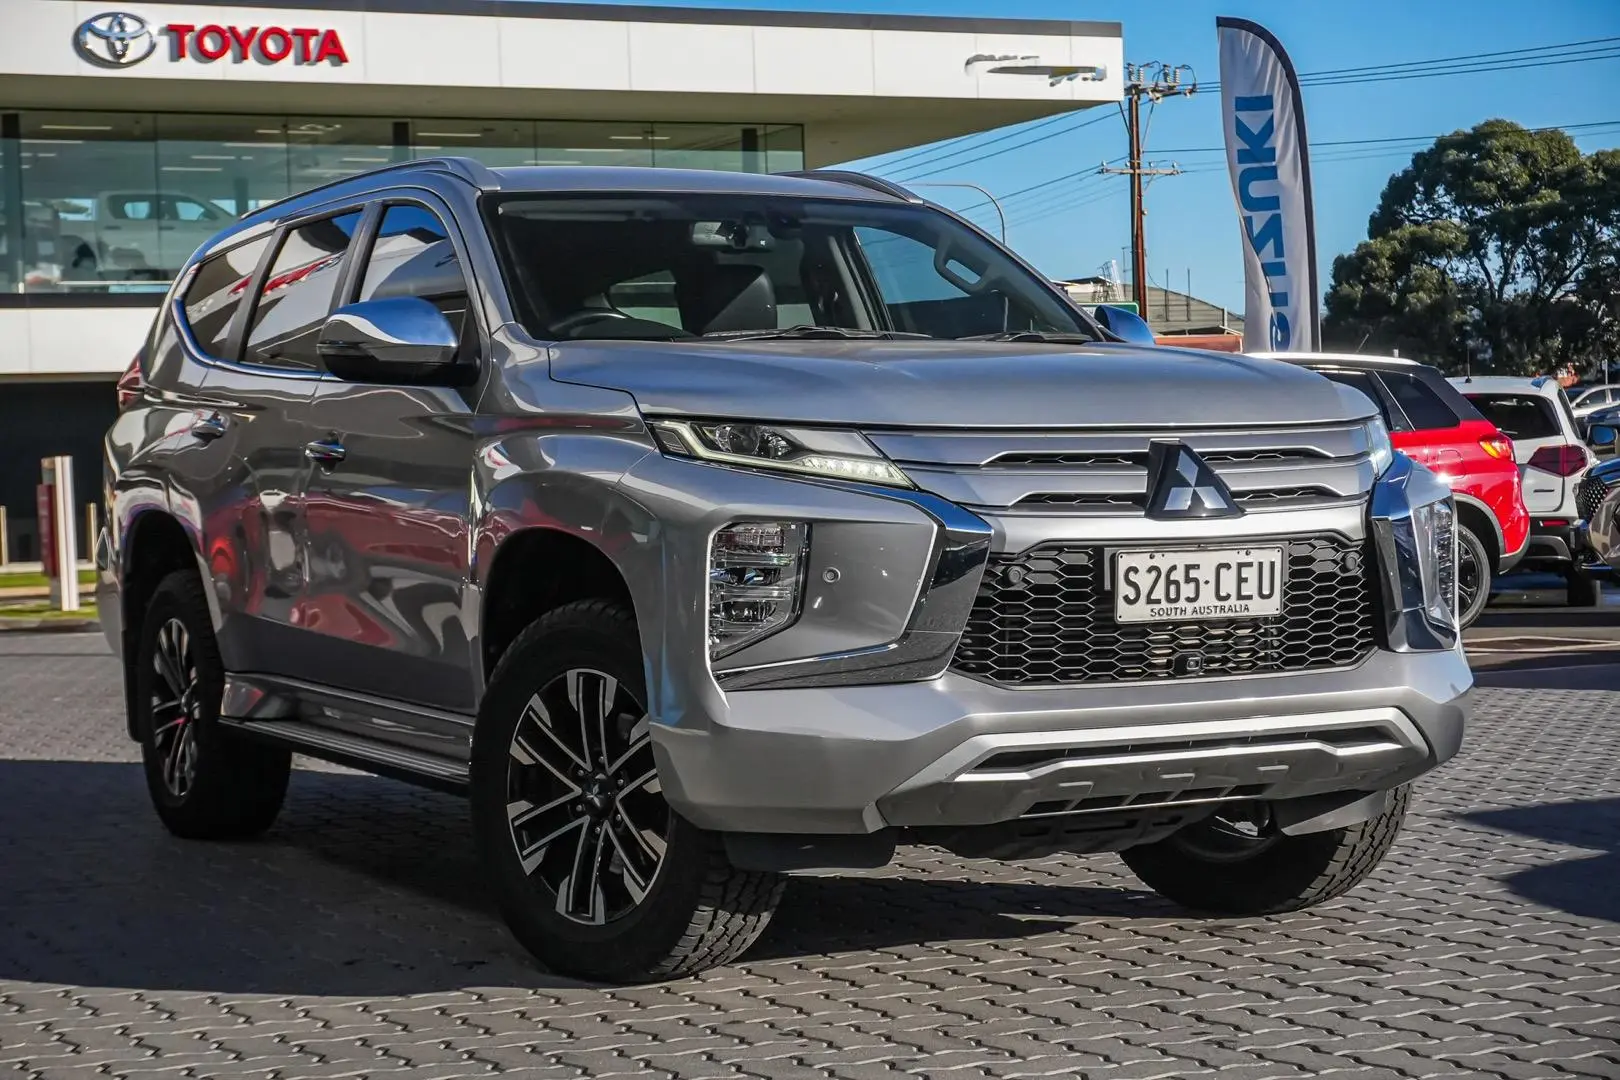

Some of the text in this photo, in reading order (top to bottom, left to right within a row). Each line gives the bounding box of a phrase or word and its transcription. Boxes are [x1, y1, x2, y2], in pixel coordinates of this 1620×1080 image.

[168, 24, 348, 63] TOYOTA
[1150, 604, 1250, 617] SOUTH AUSTRALIA
